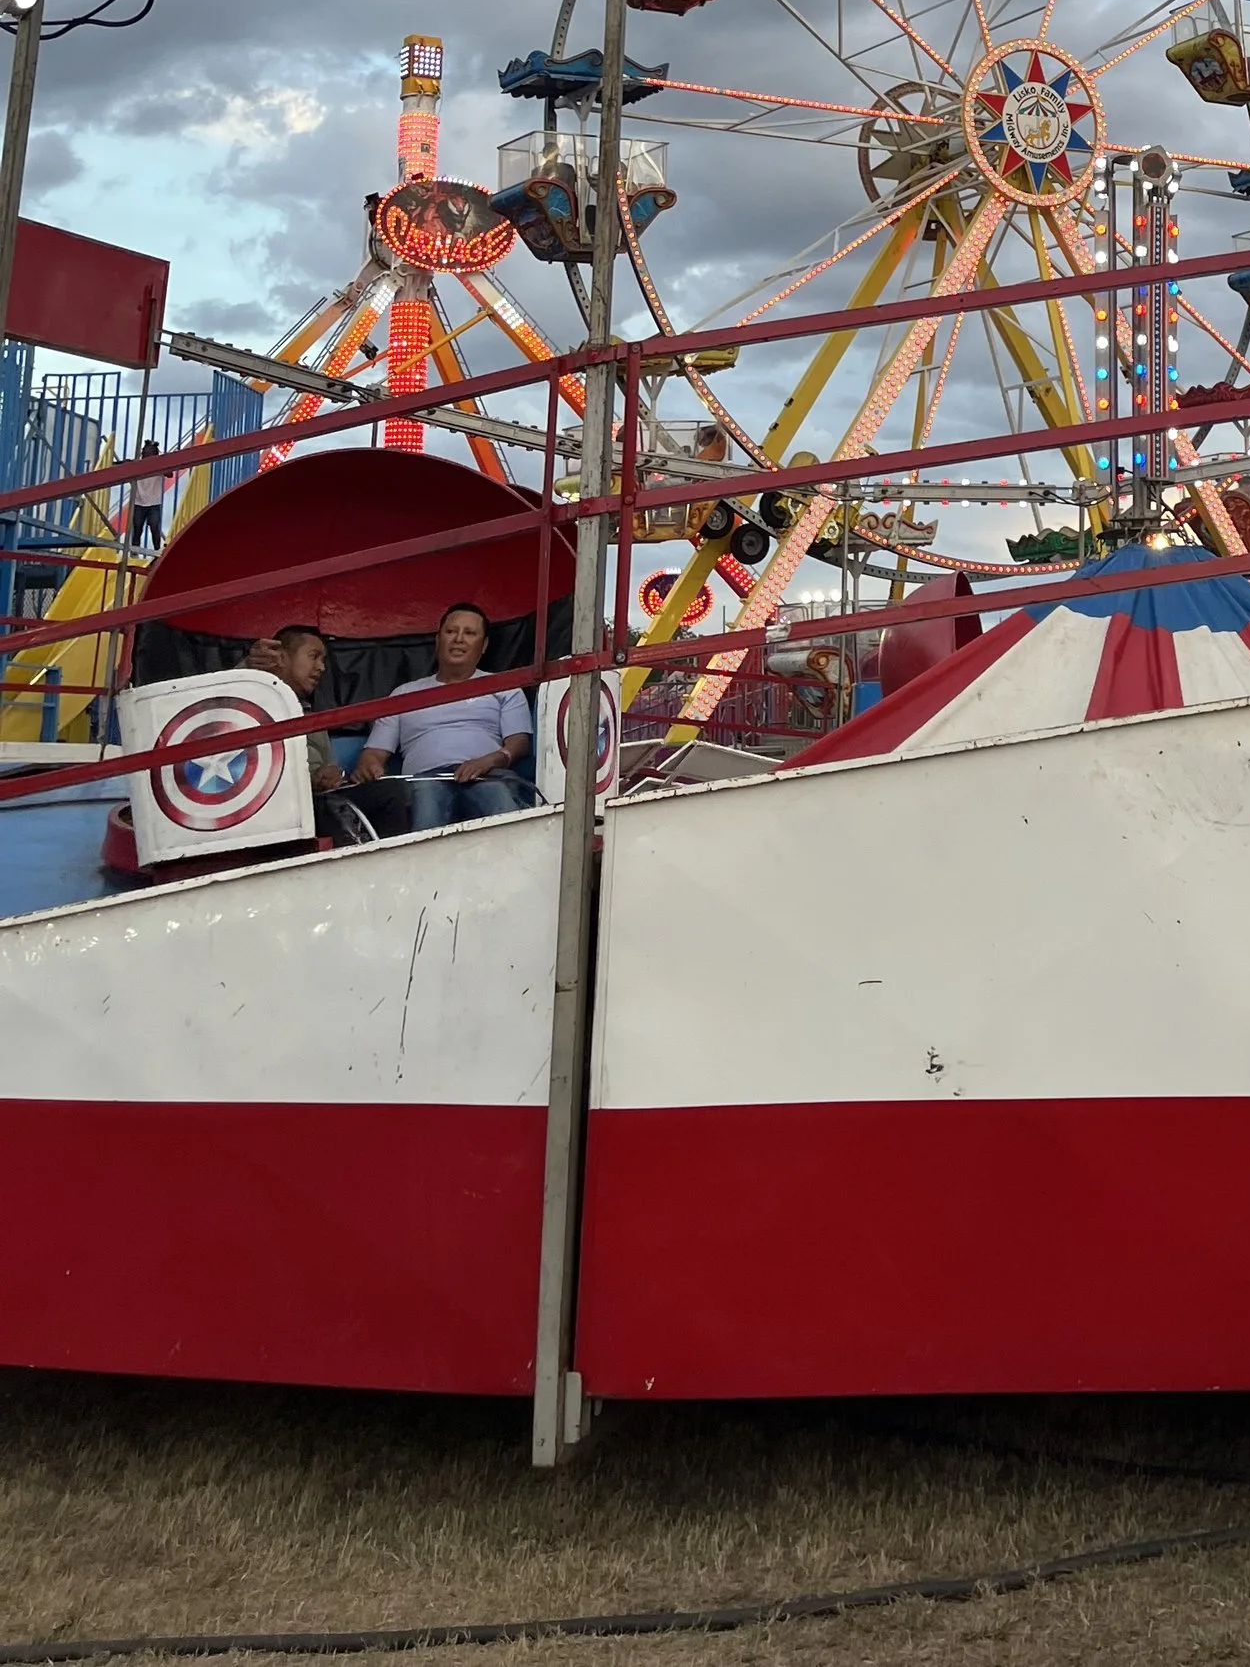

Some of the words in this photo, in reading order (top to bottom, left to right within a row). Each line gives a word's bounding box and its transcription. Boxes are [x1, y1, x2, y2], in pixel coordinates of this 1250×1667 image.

[1013, 86, 1036, 103] Lisko
[1041, 87, 1066, 114] Family
[1006, 112, 1022, 149] Midway
